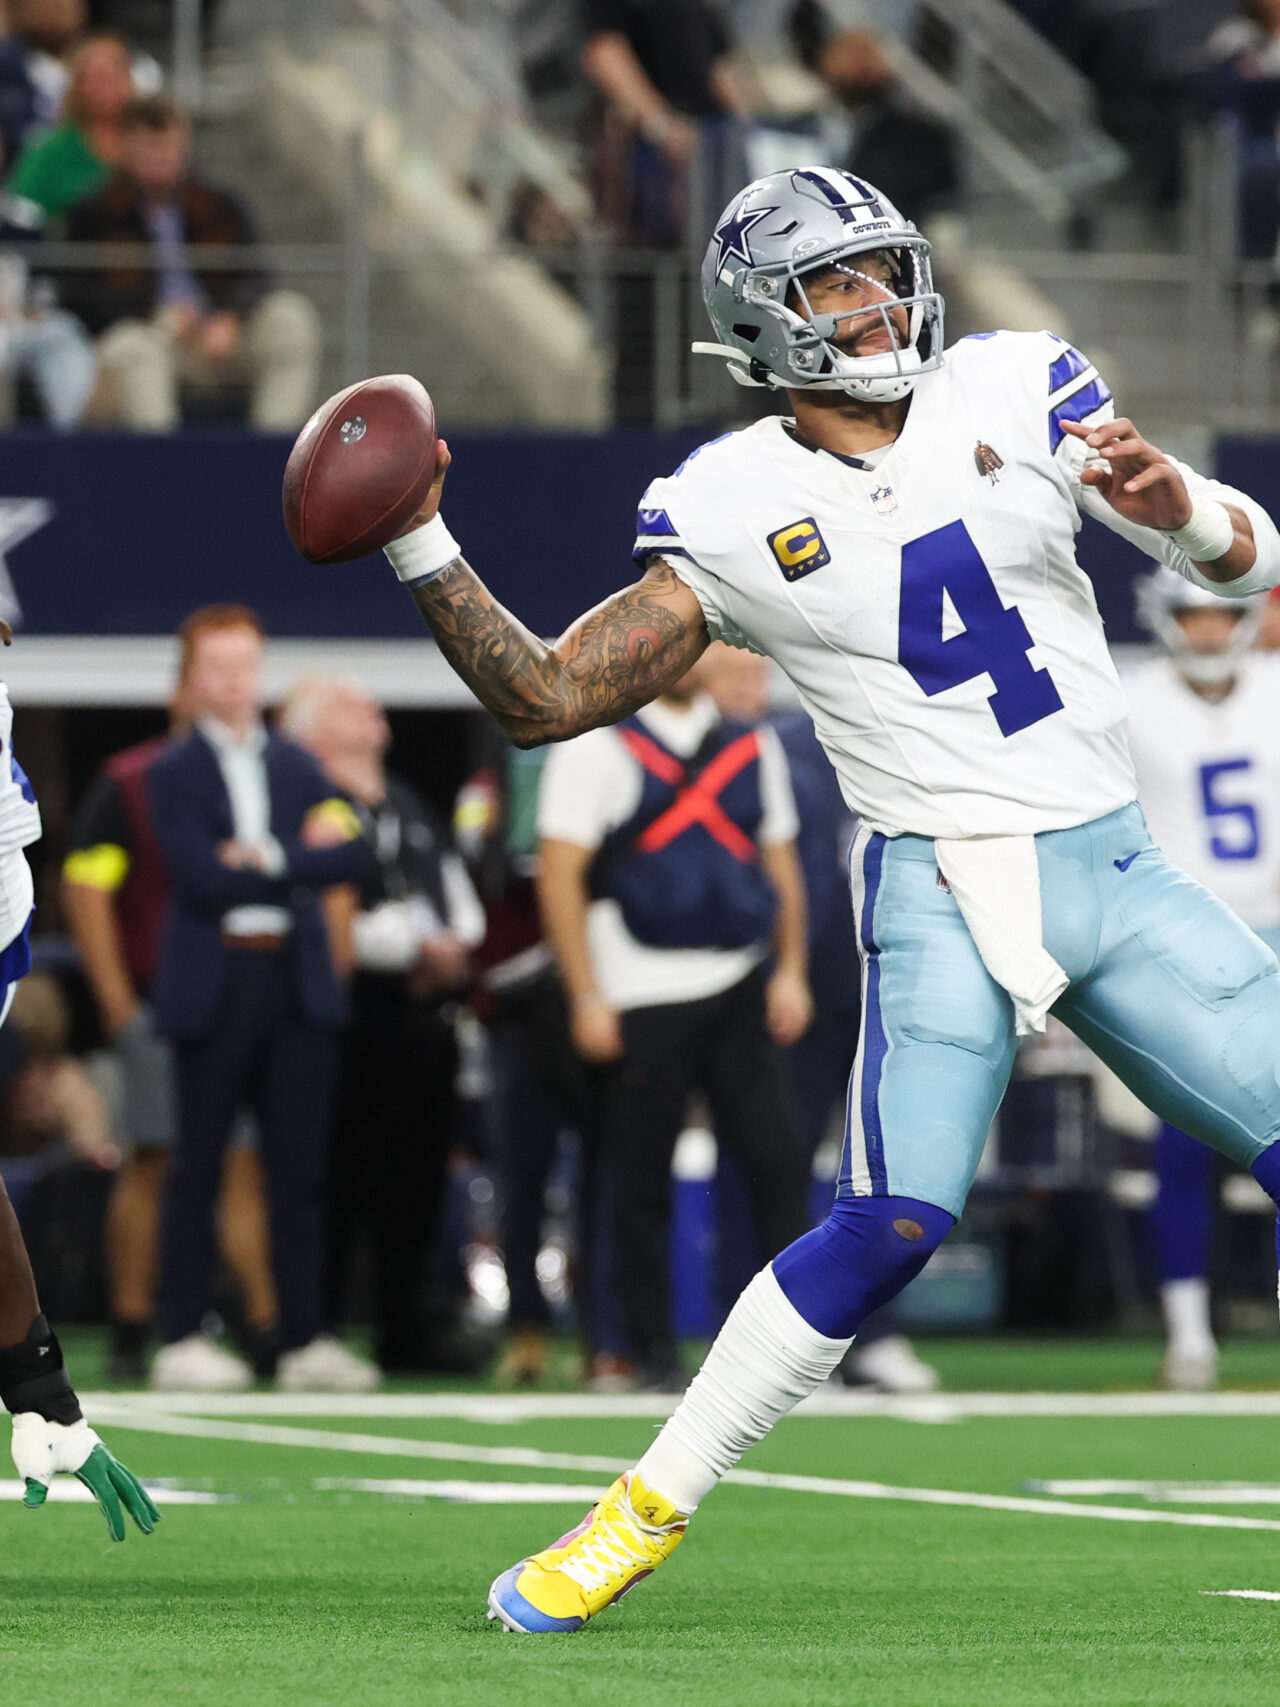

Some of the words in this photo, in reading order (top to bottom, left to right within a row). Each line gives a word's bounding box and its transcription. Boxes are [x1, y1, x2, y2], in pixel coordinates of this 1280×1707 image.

[852, 221, 891, 234] COWBOYS
[773, 522, 820, 567] C
[898, 518, 1065, 738] 4
[1200, 759, 1259, 859] 5
